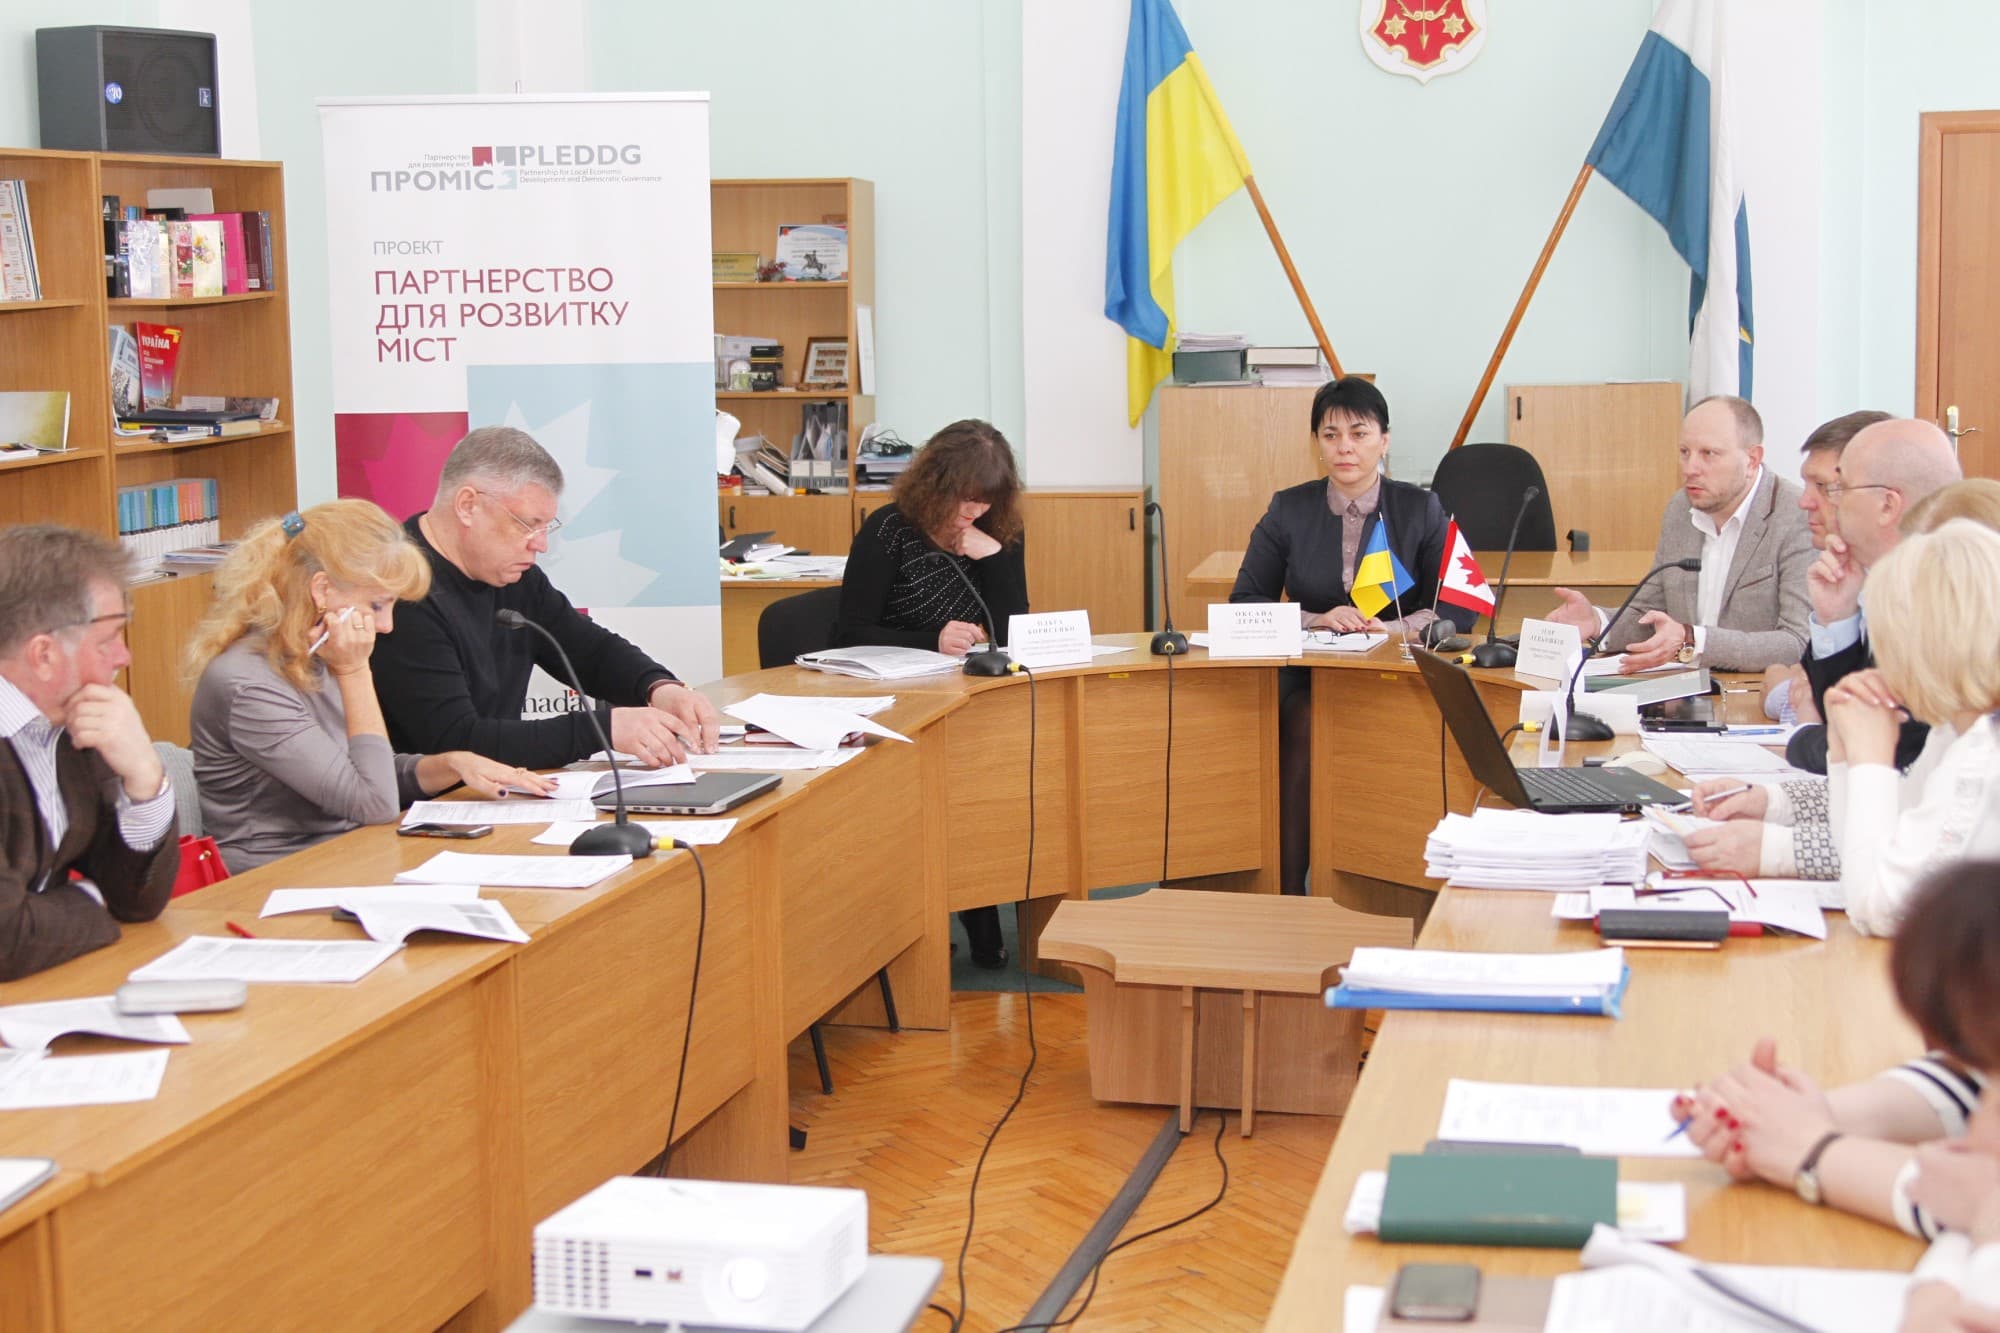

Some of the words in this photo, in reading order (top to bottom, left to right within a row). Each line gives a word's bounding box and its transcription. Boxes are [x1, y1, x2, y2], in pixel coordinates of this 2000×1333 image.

[519, 144, 642, 166] PLEDDG
[370, 169, 495, 192] ПРОМІС
[519, 169, 559, 177] Partnership
[372, 240, 444, 256] ПРОЕКТ
[375, 267, 614, 295] ПАРТНЕРСТВО
[375, 303, 447, 335] ДЛЯ
[459, 301, 630, 328] РОЗВИТКУ
[377, 337, 457, 363] МІСТ
[522, 689, 584, 714] nada
